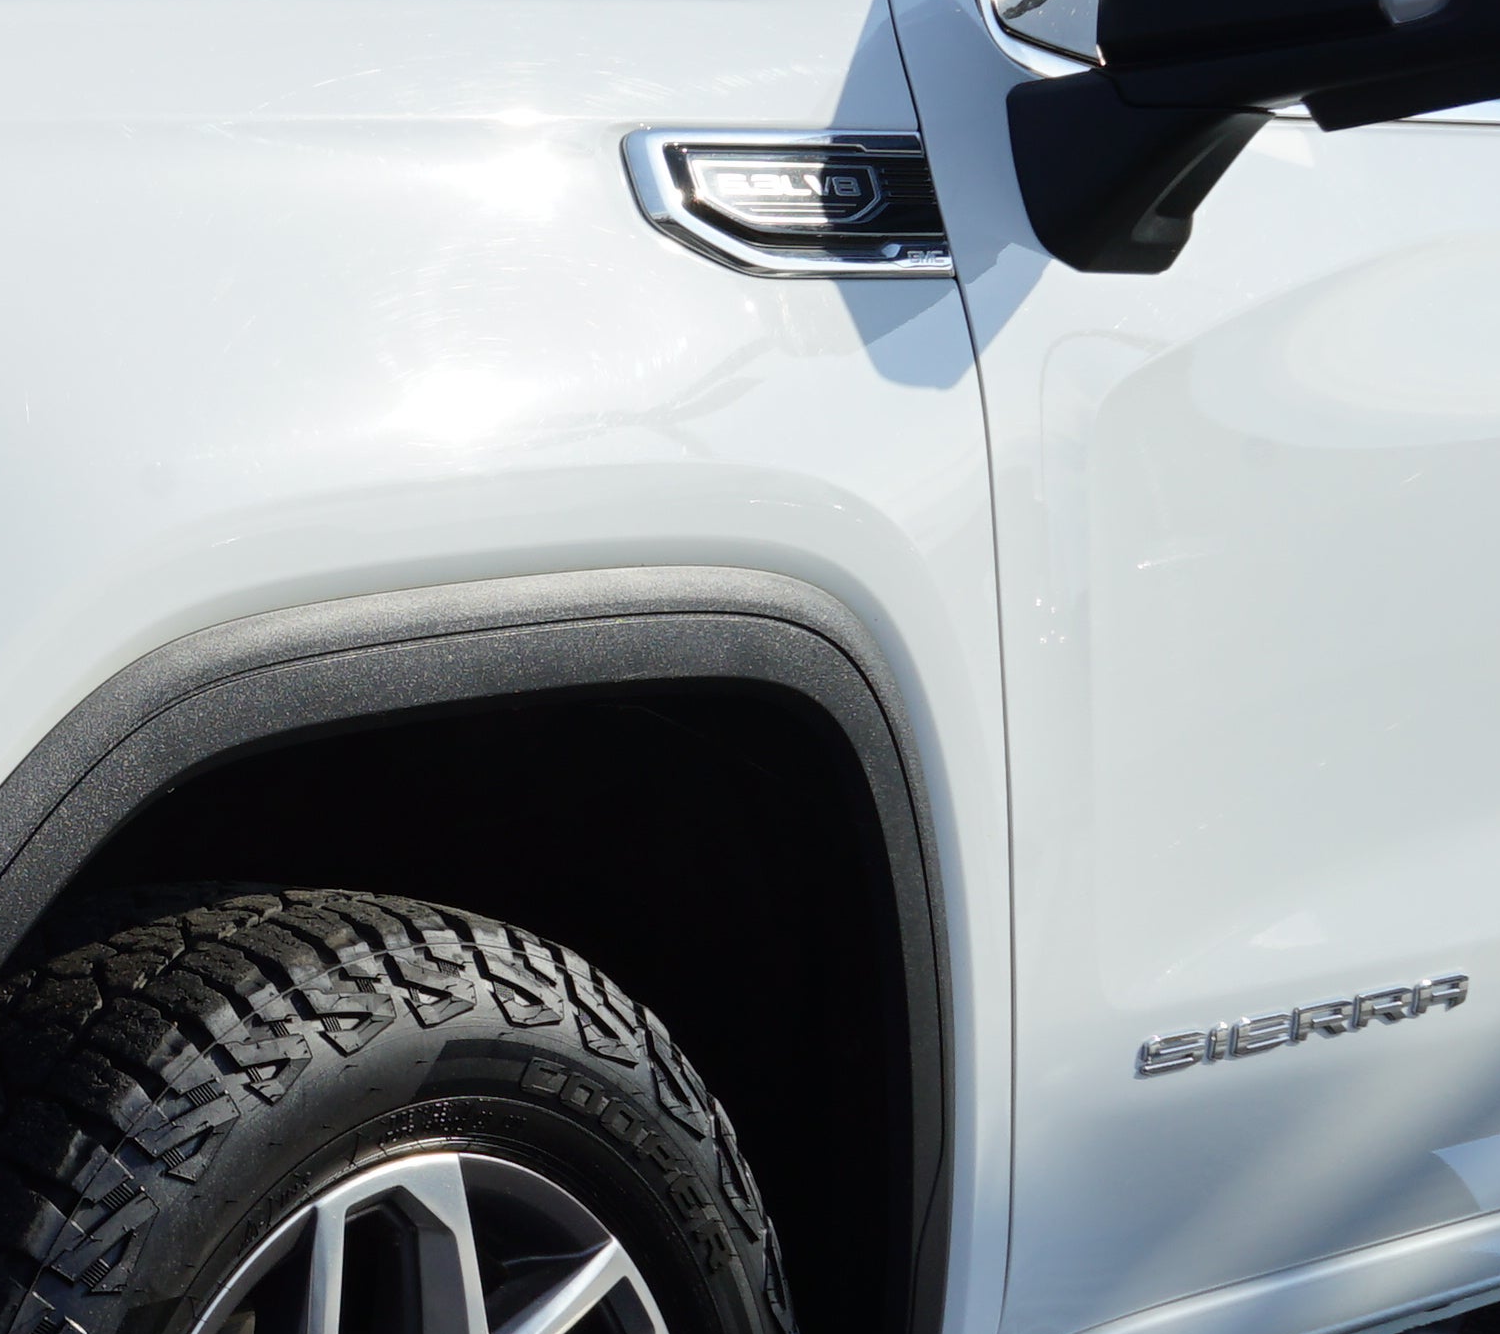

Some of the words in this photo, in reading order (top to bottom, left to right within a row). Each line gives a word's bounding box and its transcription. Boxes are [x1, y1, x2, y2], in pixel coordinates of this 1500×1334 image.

[906, 250, 946, 265] GMC
[1134, 972, 1470, 1079] SIERRA
[520, 1056, 738, 1275] COOPER
